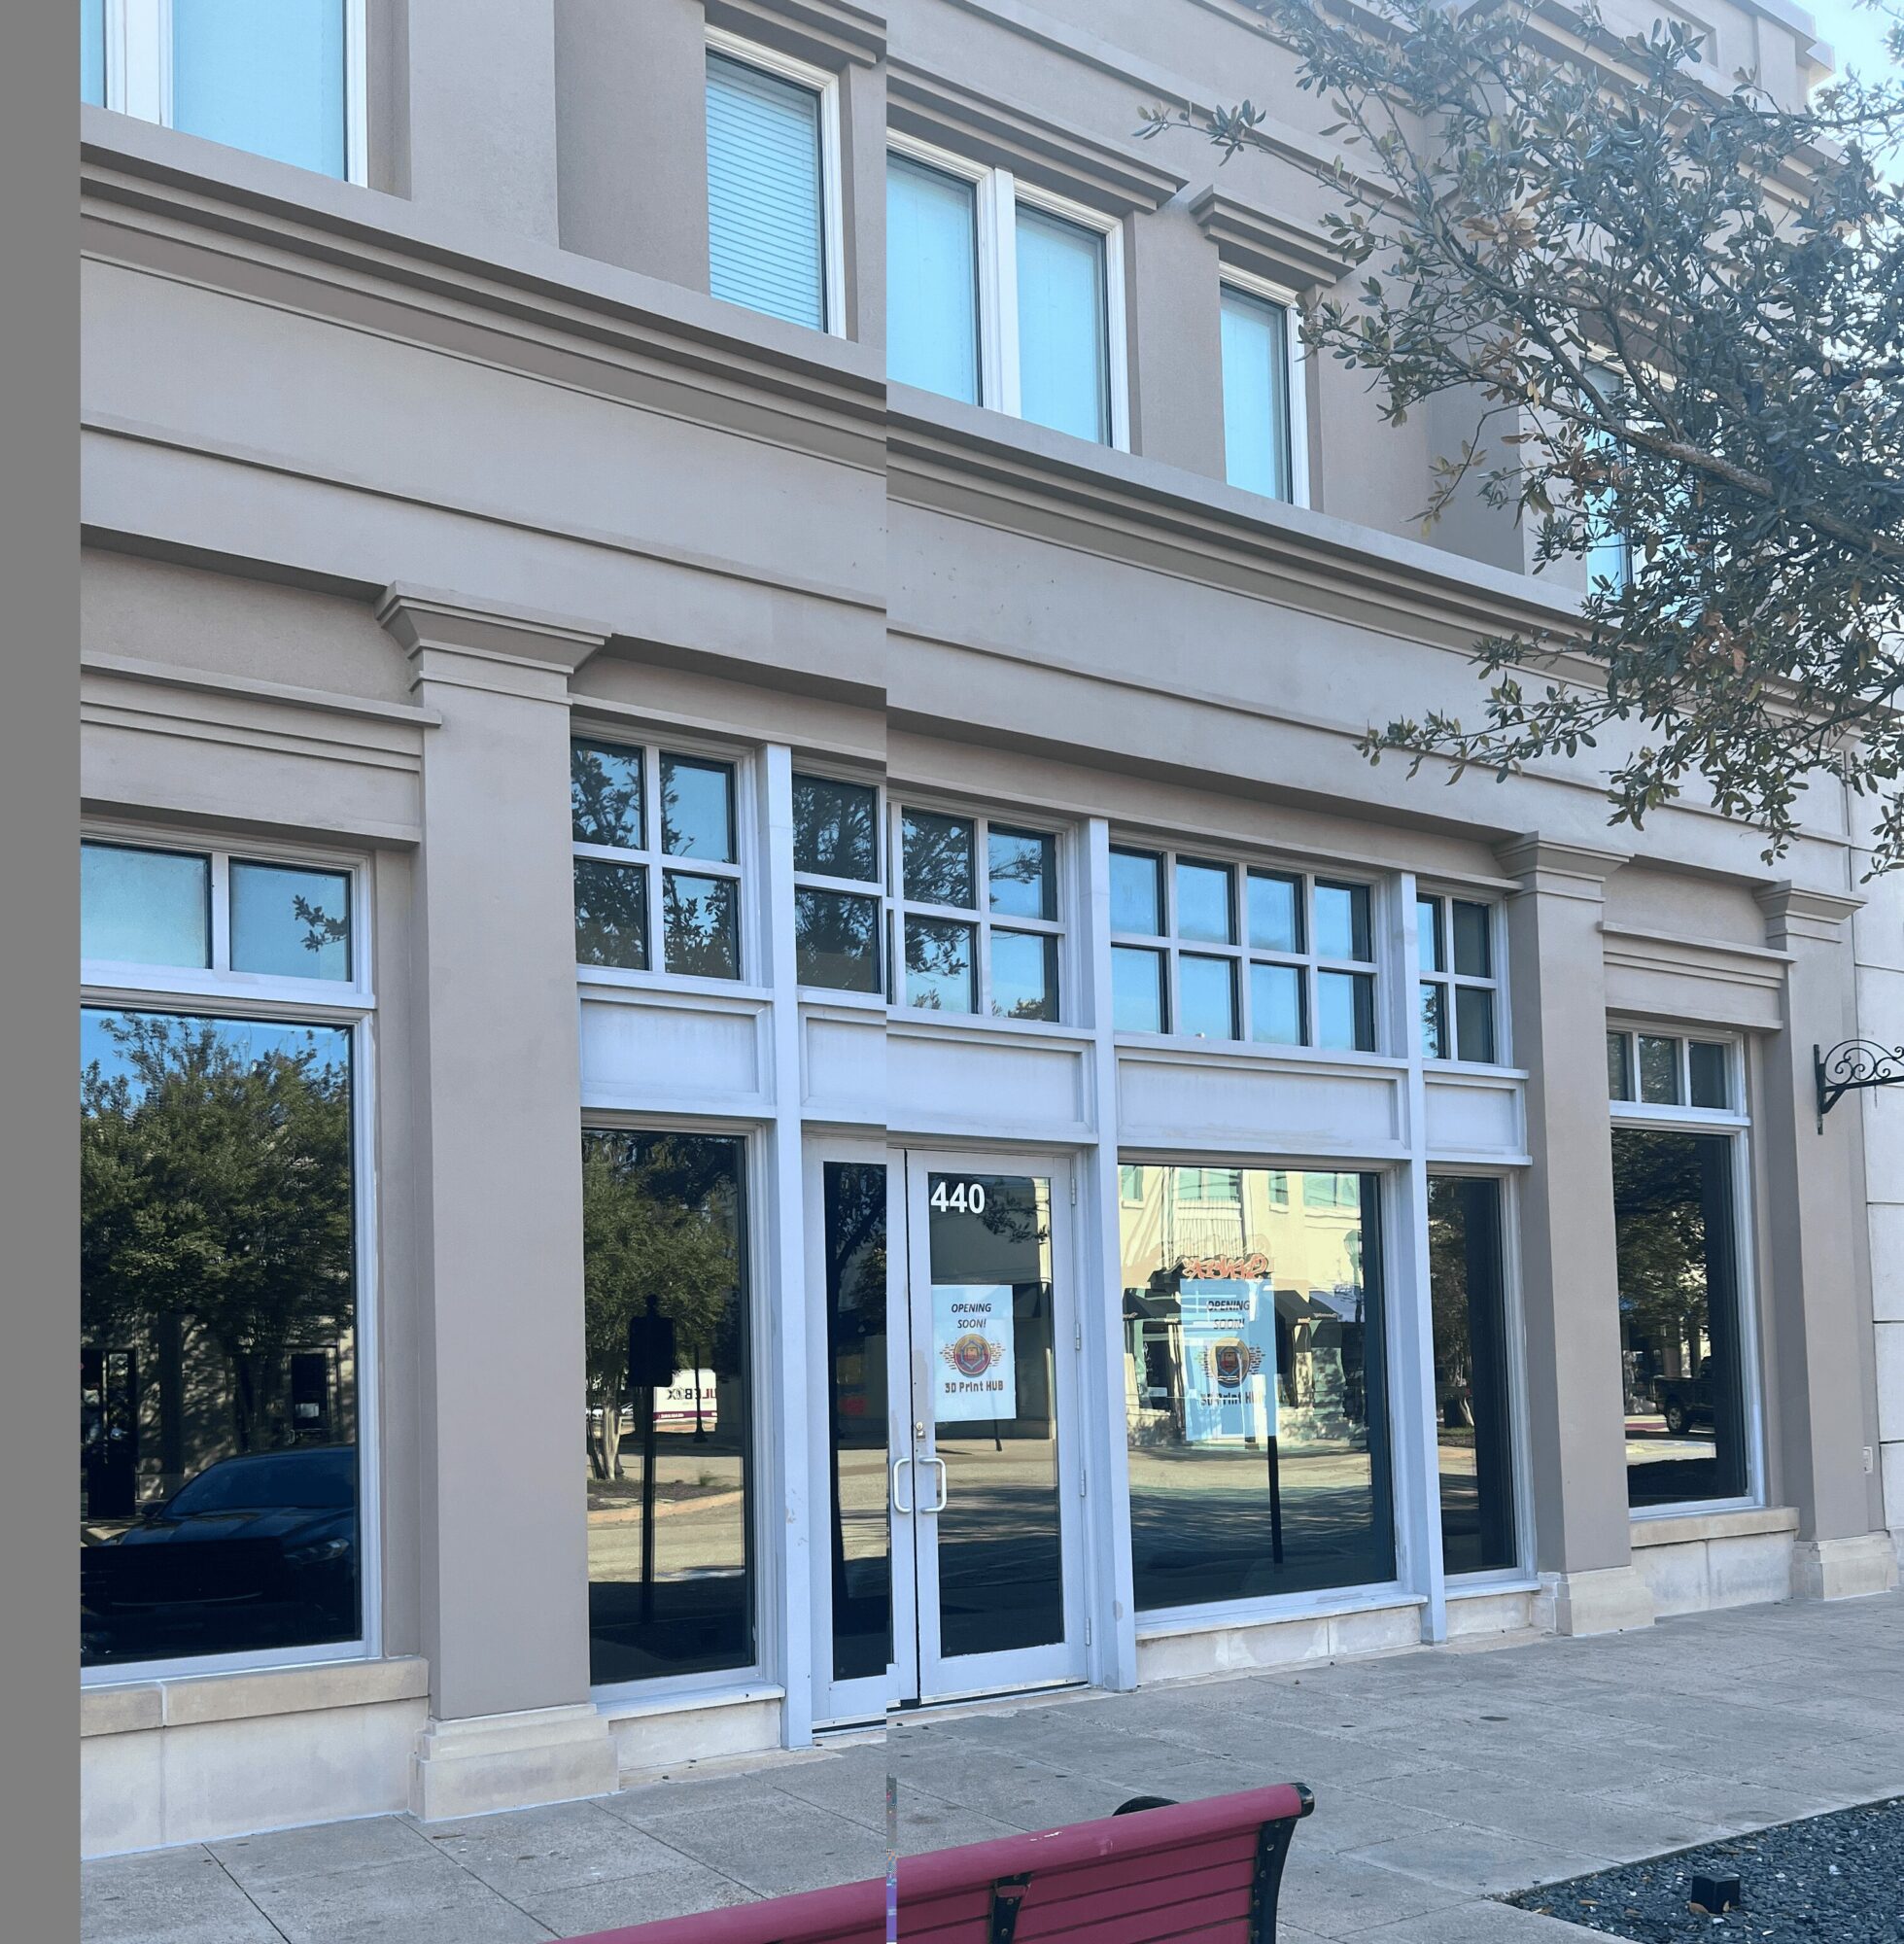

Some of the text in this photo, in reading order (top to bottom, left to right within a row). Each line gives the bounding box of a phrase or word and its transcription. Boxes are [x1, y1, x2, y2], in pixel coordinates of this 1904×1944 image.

[930, 1181, 986, 1214] 440
[951, 1303, 992, 1313] OPENING
[1207, 1300, 1250, 1311] OPENING
[956, 1319, 987, 1329] SOON!
[945, 1382, 956, 1394] 3D
[986, 1380, 1004, 1392] HUB
